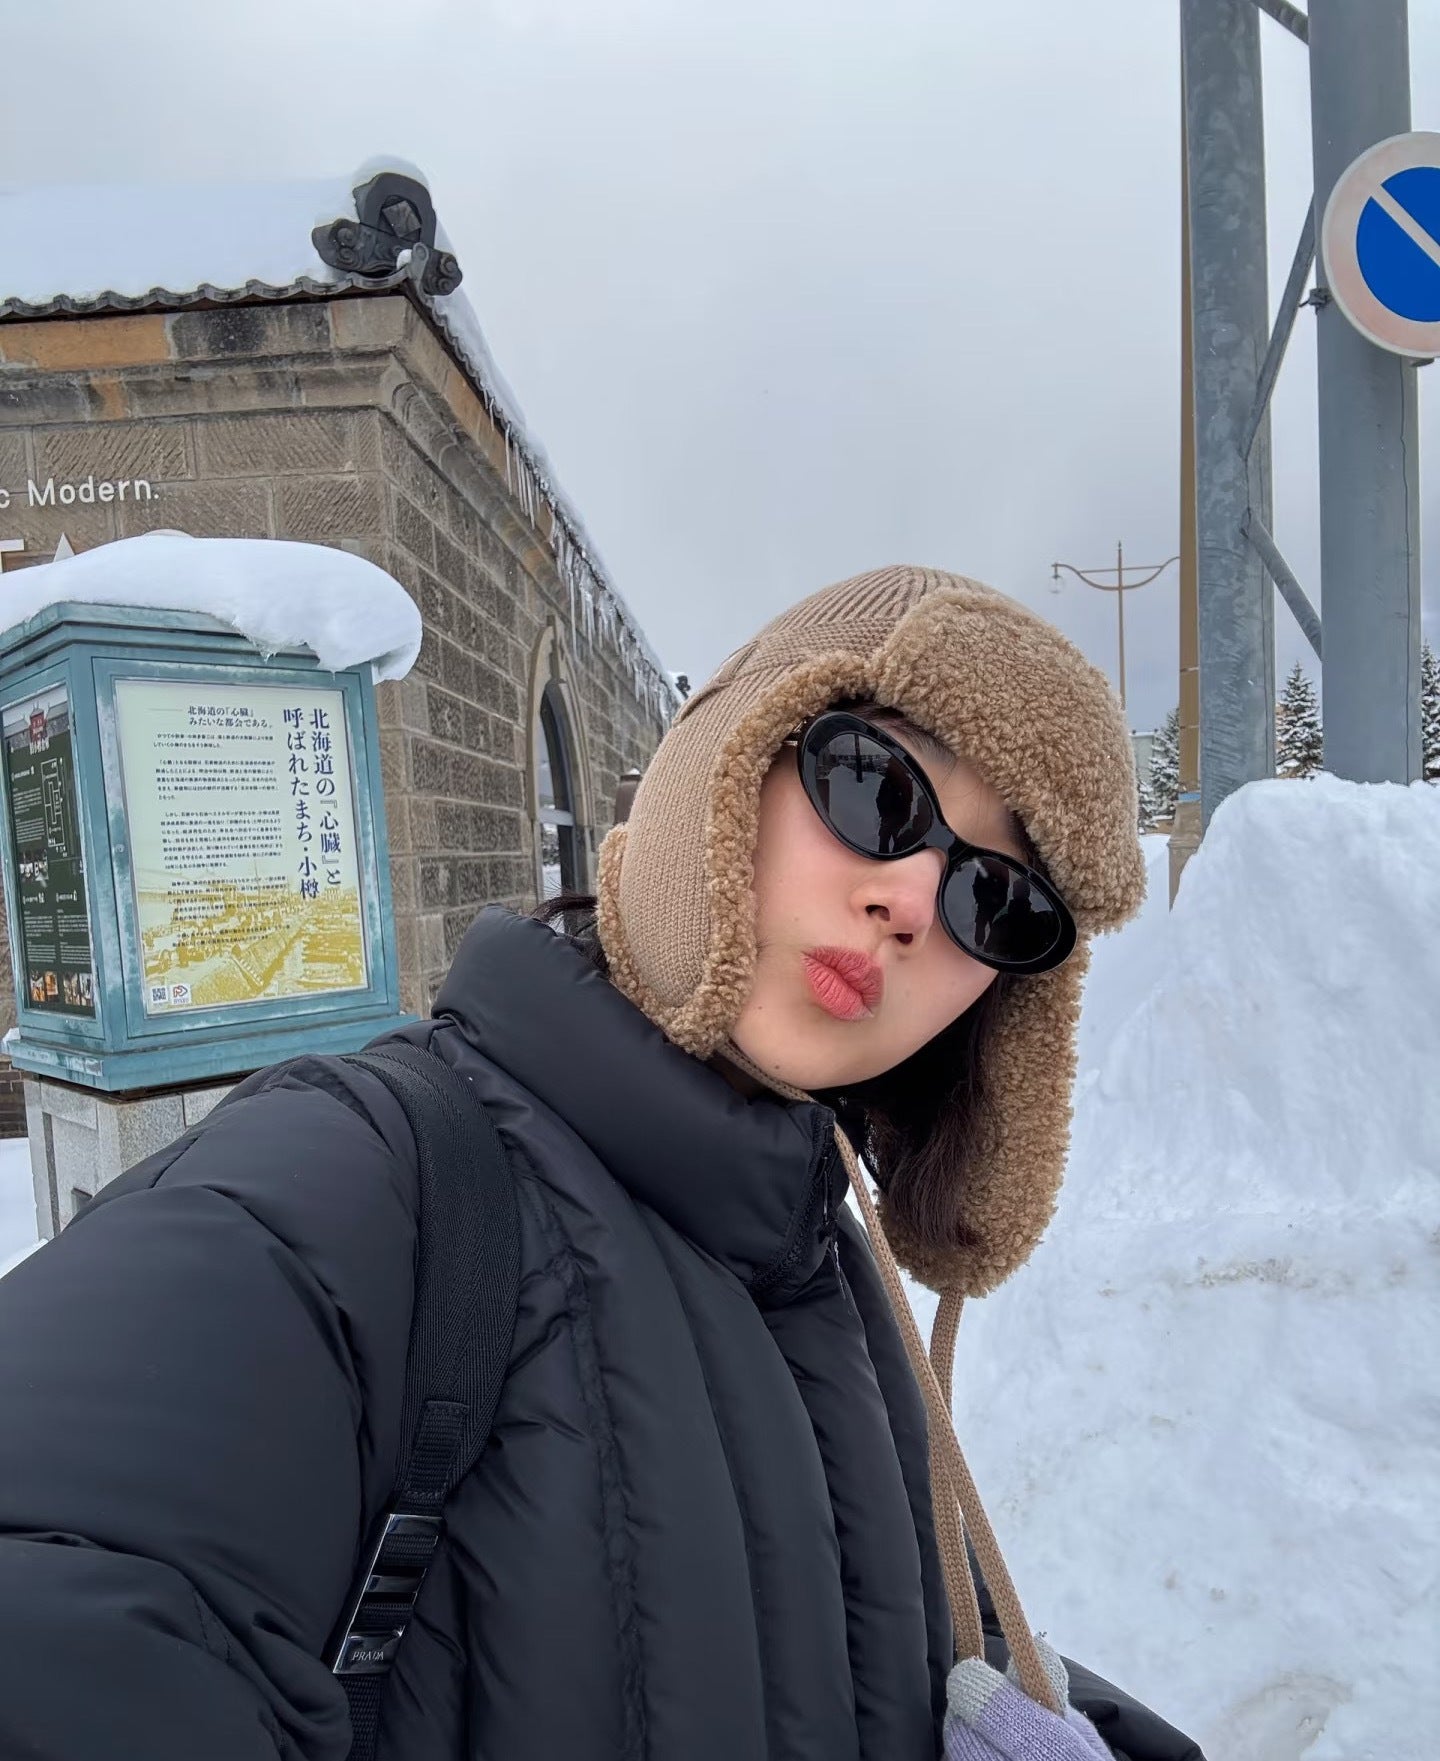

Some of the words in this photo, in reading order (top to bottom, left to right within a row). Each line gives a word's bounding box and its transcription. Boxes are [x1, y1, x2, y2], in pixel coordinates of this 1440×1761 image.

[27, 475, 160, 507] Modern.
[283, 707, 320, 900] 呼ばれたまち・小樽
[309, 708, 342, 886] 北海道の『心臓』と
[352, 1651, 384, 1661] PRADA
